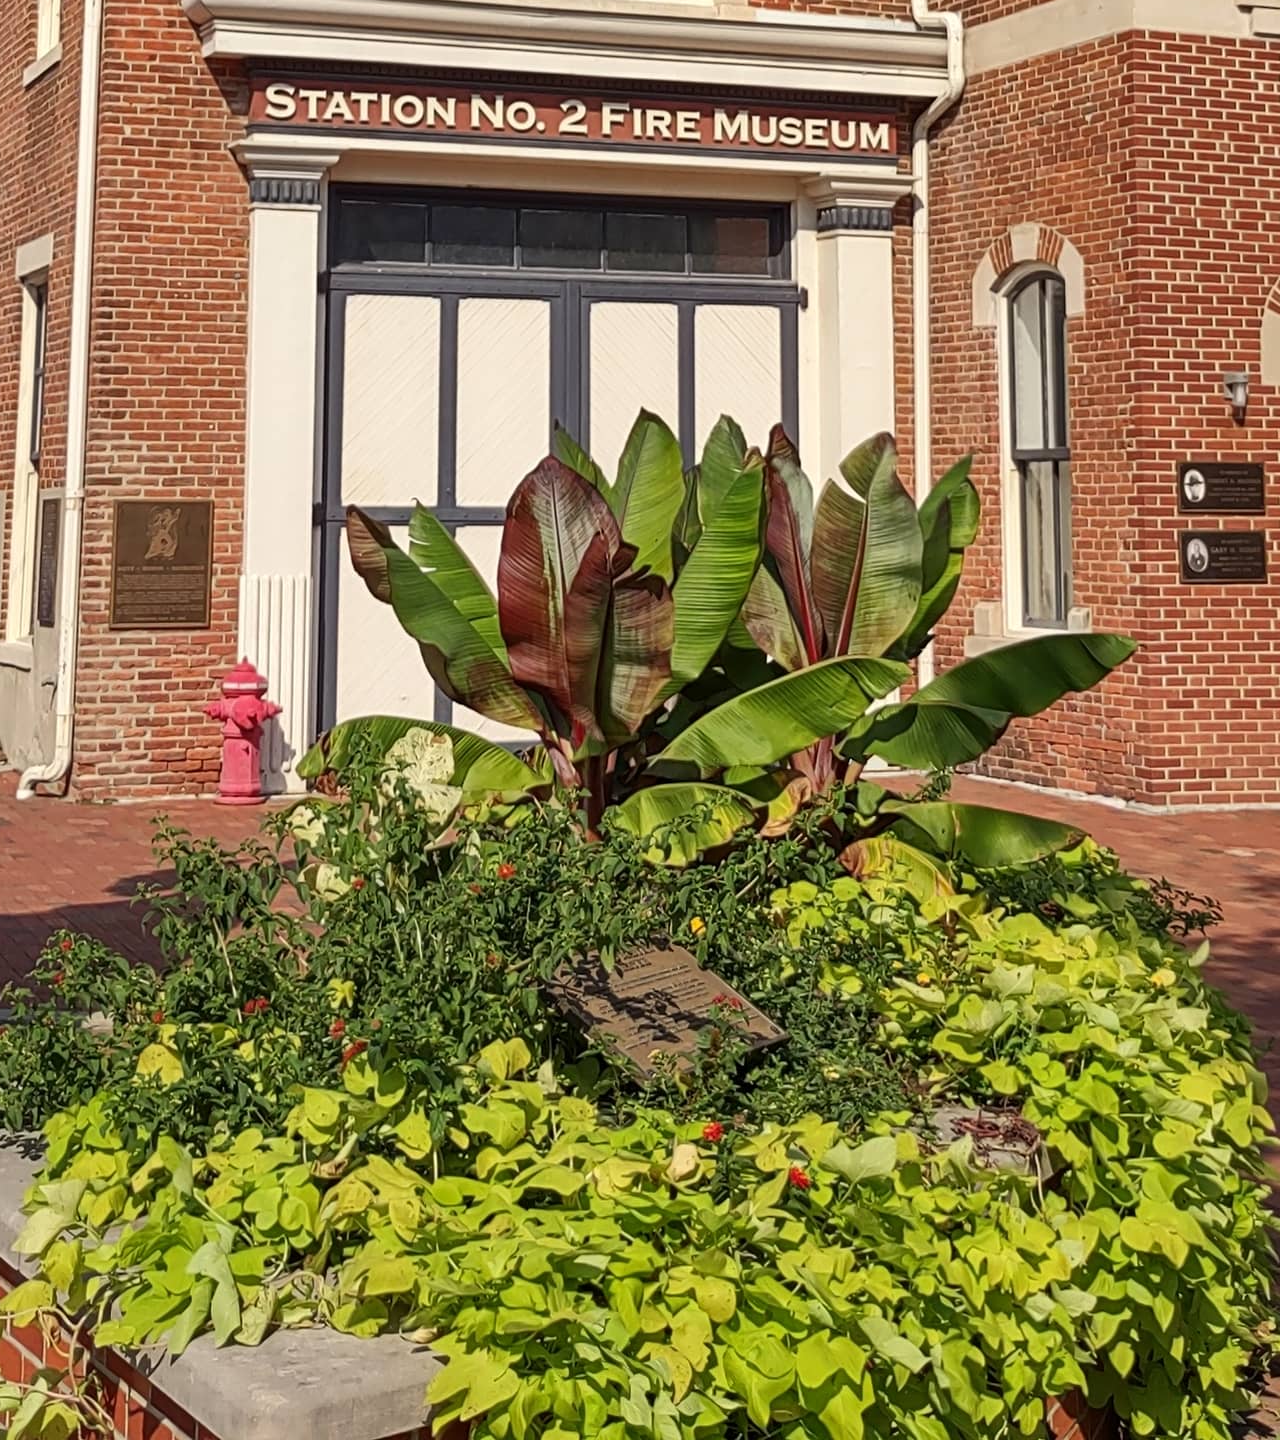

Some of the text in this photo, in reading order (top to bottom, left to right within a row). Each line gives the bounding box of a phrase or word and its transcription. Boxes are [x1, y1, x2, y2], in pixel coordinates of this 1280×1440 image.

[557, 99, 589, 136] 2
[601, 101, 702, 141] FIRE
[713, 108, 891, 151] MUSEUM
